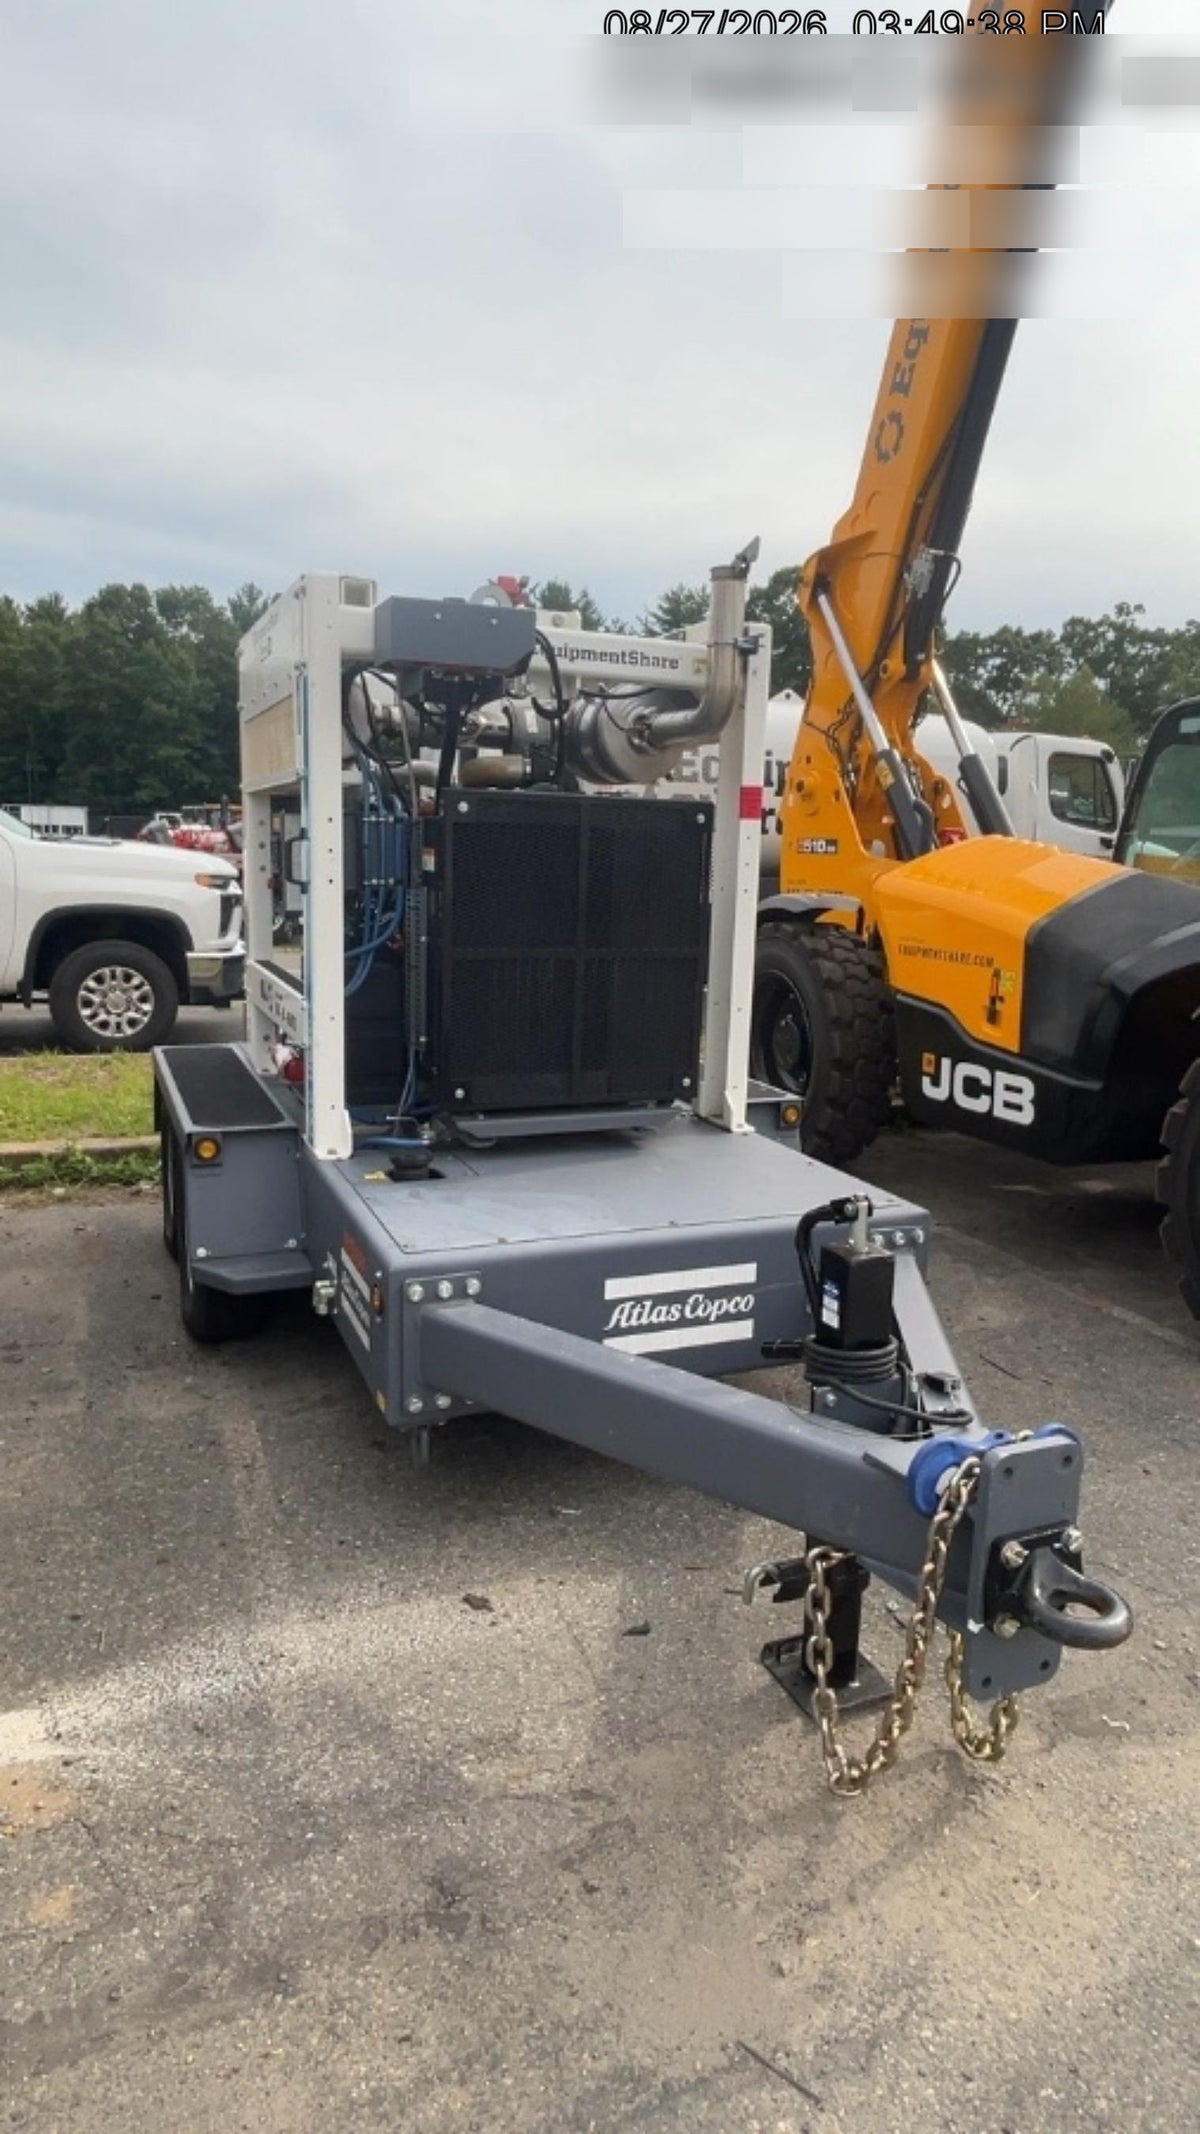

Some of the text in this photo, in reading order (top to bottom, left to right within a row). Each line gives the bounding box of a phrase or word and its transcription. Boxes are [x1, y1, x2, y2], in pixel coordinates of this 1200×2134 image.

[552, 642, 680, 669] uipmentShare
[922, 1056, 1035, 1125] JCB
[602, 1294, 756, 1331] Atlas Copco
